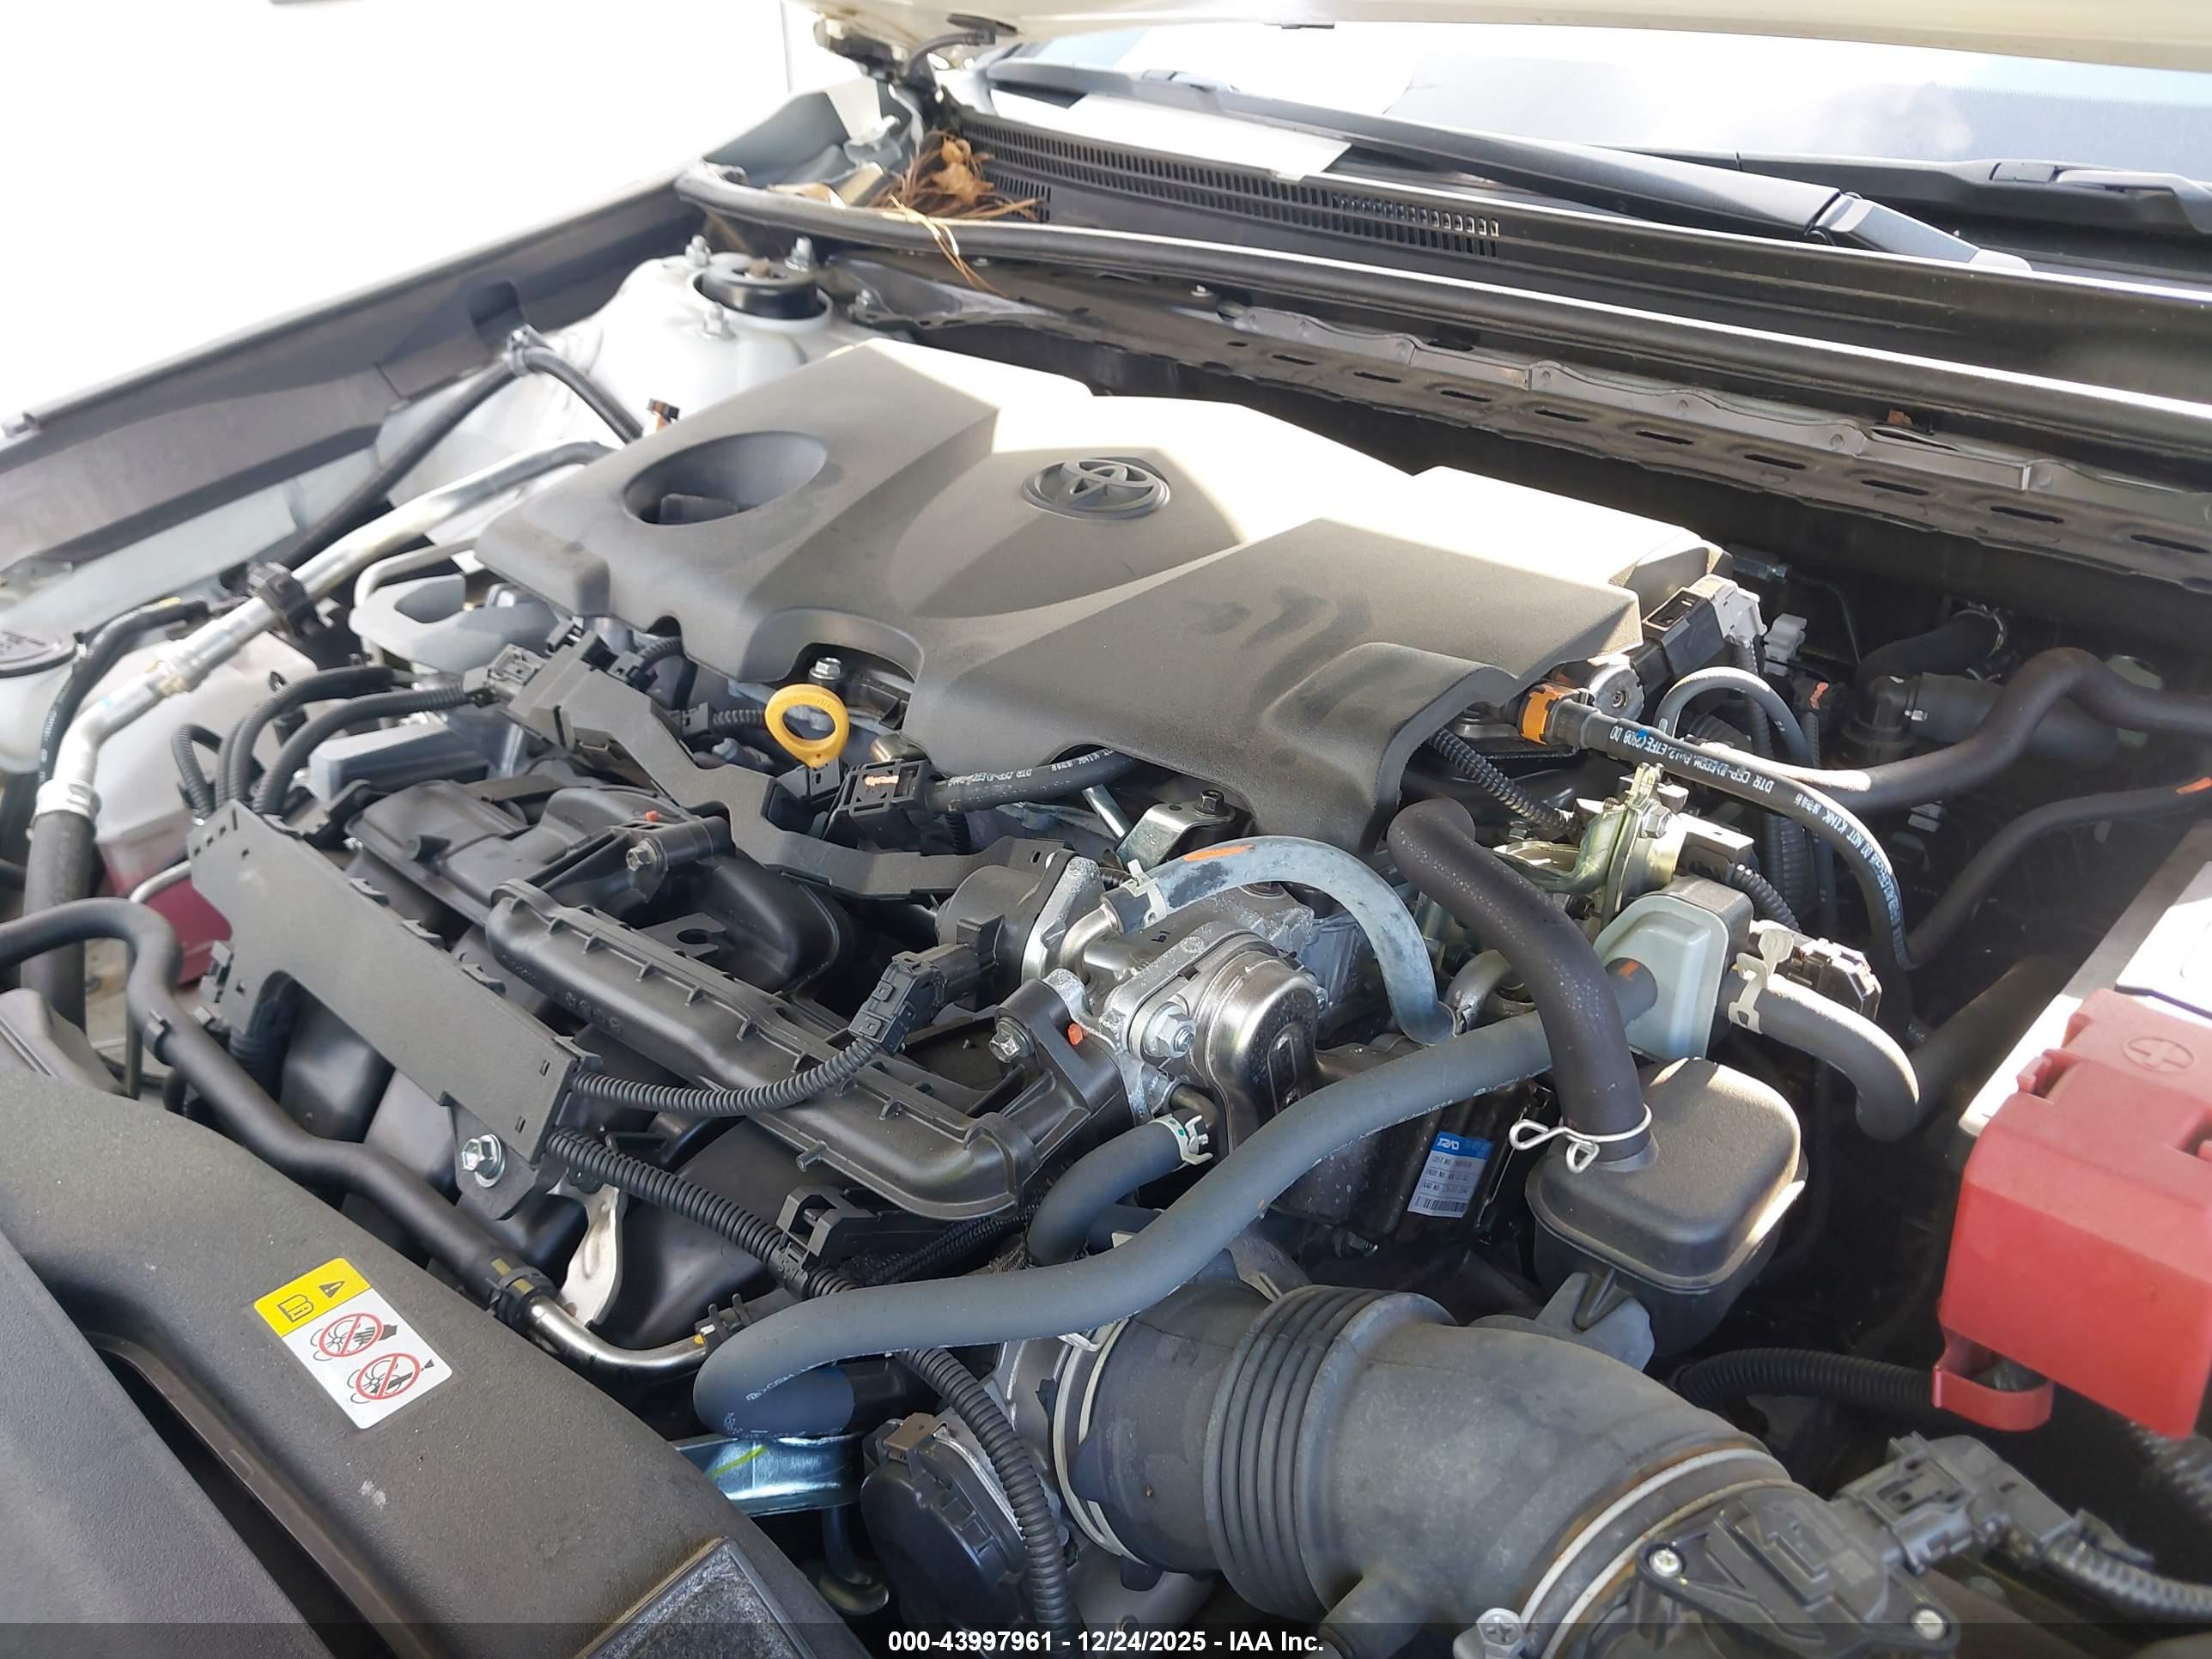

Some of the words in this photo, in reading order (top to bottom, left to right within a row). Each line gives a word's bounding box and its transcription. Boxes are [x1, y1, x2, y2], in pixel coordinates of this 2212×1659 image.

[1752, 775, 1775, 794] DTR
[1822, 809, 1849, 835] KINK
[1846, 831, 1864, 849] NOT
